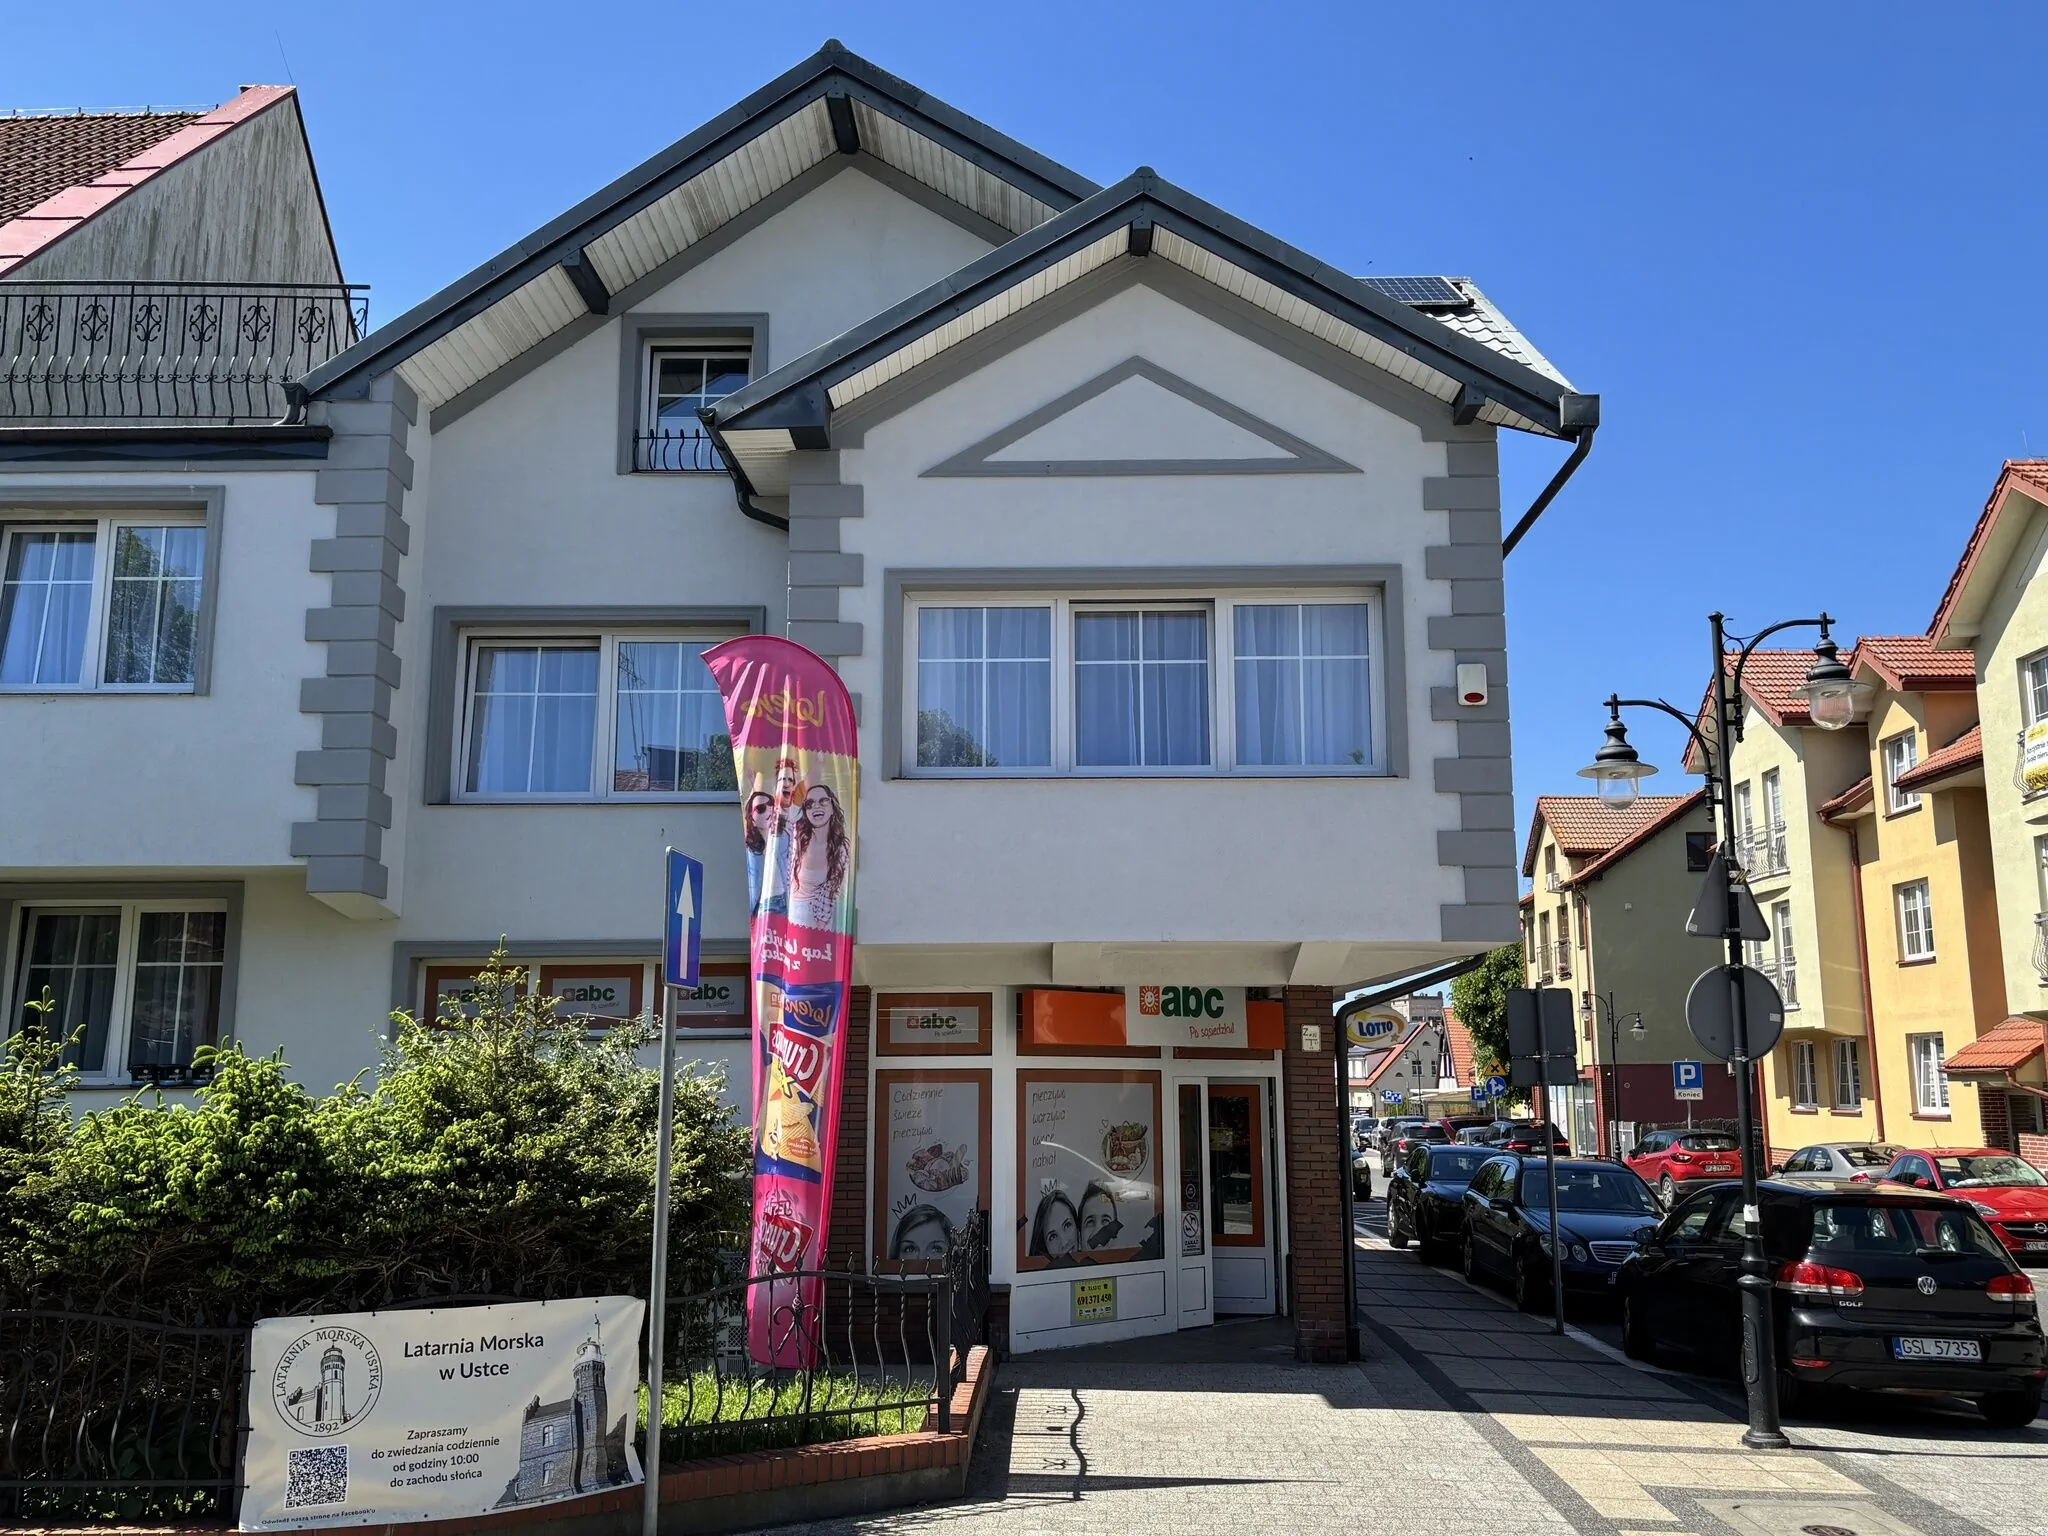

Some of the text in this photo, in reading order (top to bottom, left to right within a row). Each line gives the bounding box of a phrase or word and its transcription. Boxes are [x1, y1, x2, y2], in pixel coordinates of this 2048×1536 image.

[575, 984, 615, 1002] abc
[690, 982, 730, 1001] abc
[1160, 985, 1225, 1019] abc
[919, 1012, 958, 1030] abc
[1357, 1020, 1394, 1037] LOTTO
[1679, 1064, 1696, 1086] P
[1677, 1090, 1701, 1098] Koniec
[1838, 1300, 1864, 1308] GOLF
[404, 1333, 544, 1358] Latarnia Morska
[1902, 1339, 1980, 1357] GSL 57353
[276, 1329, 379, 1398] LATARNIA MORSKA USTKA
[439, 1361, 510, 1381] w Ustce
[314, 1421, 340, 1434] 1892
[406, 1425, 469, 1441] Zapraszamy
[371, 1436, 500, 1460] do zwiedzania codziennie
[392, 1453, 480, 1473] od godziny 10:00
[389, 1468, 483, 1488] do zachodu słońca
